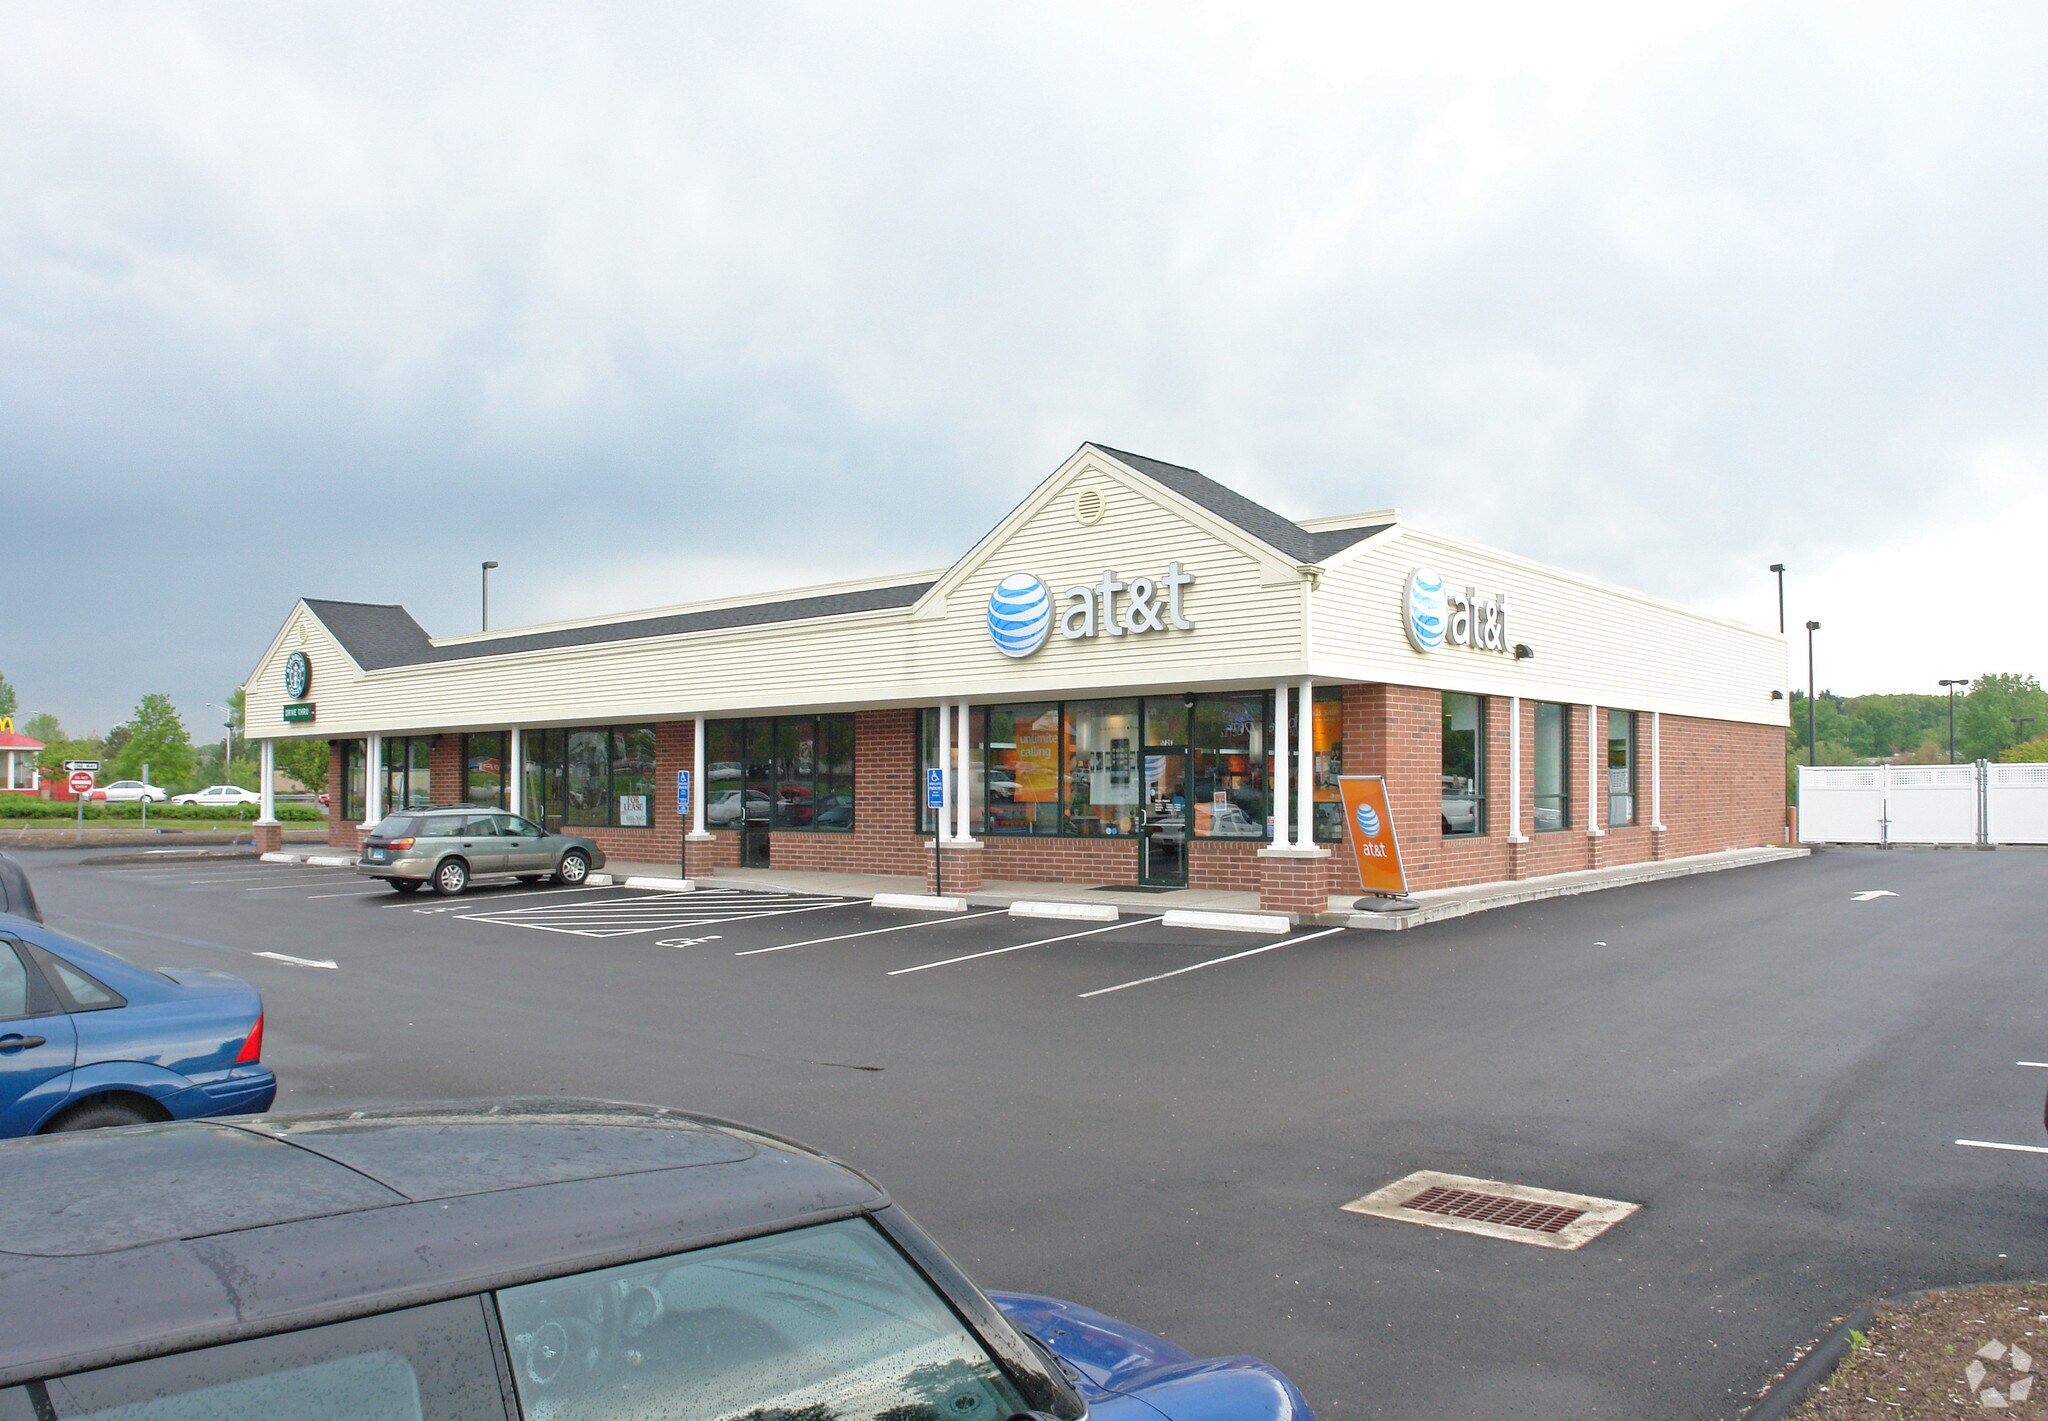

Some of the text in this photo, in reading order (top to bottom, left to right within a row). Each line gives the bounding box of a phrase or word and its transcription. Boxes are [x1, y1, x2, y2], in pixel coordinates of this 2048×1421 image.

[1060, 561, 1196, 640] at&t
[1445, 586, 1515, 654] at&t
[285, 707, 309, 717] DRIVE THRU
[1020, 747, 1051, 760] calling
[623, 803, 644, 811] LEASE
[1363, 841, 1388, 858] at&t
